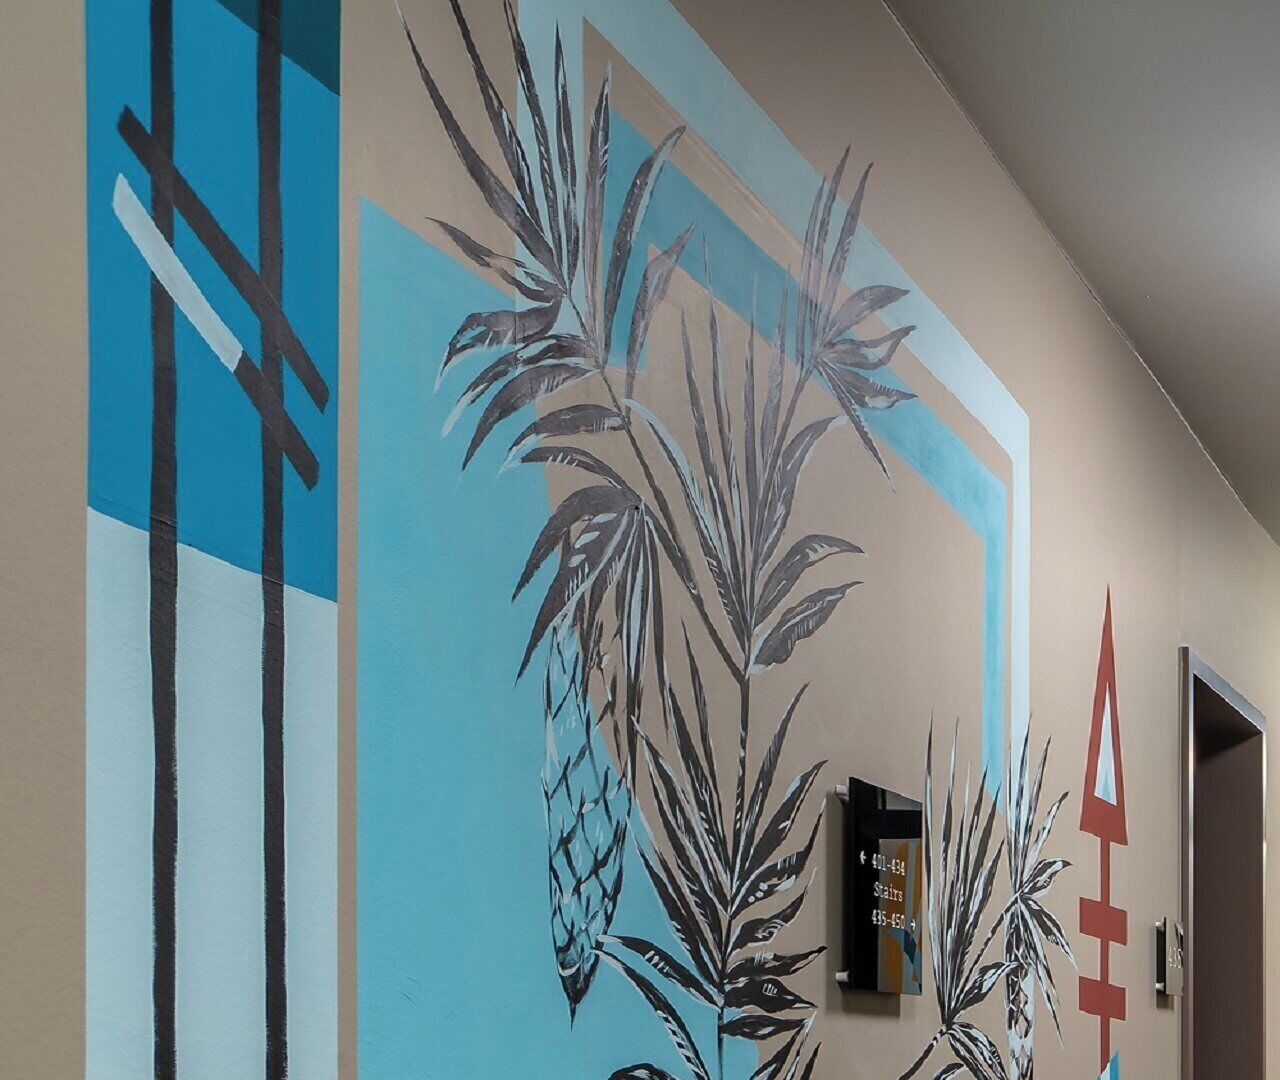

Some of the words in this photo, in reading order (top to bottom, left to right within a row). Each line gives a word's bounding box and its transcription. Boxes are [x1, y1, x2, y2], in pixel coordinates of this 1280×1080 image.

[872, 854, 905, 876] 401-434
[874, 881, 903, 902] Stairs
[872, 909, 905, 929] 435-450
